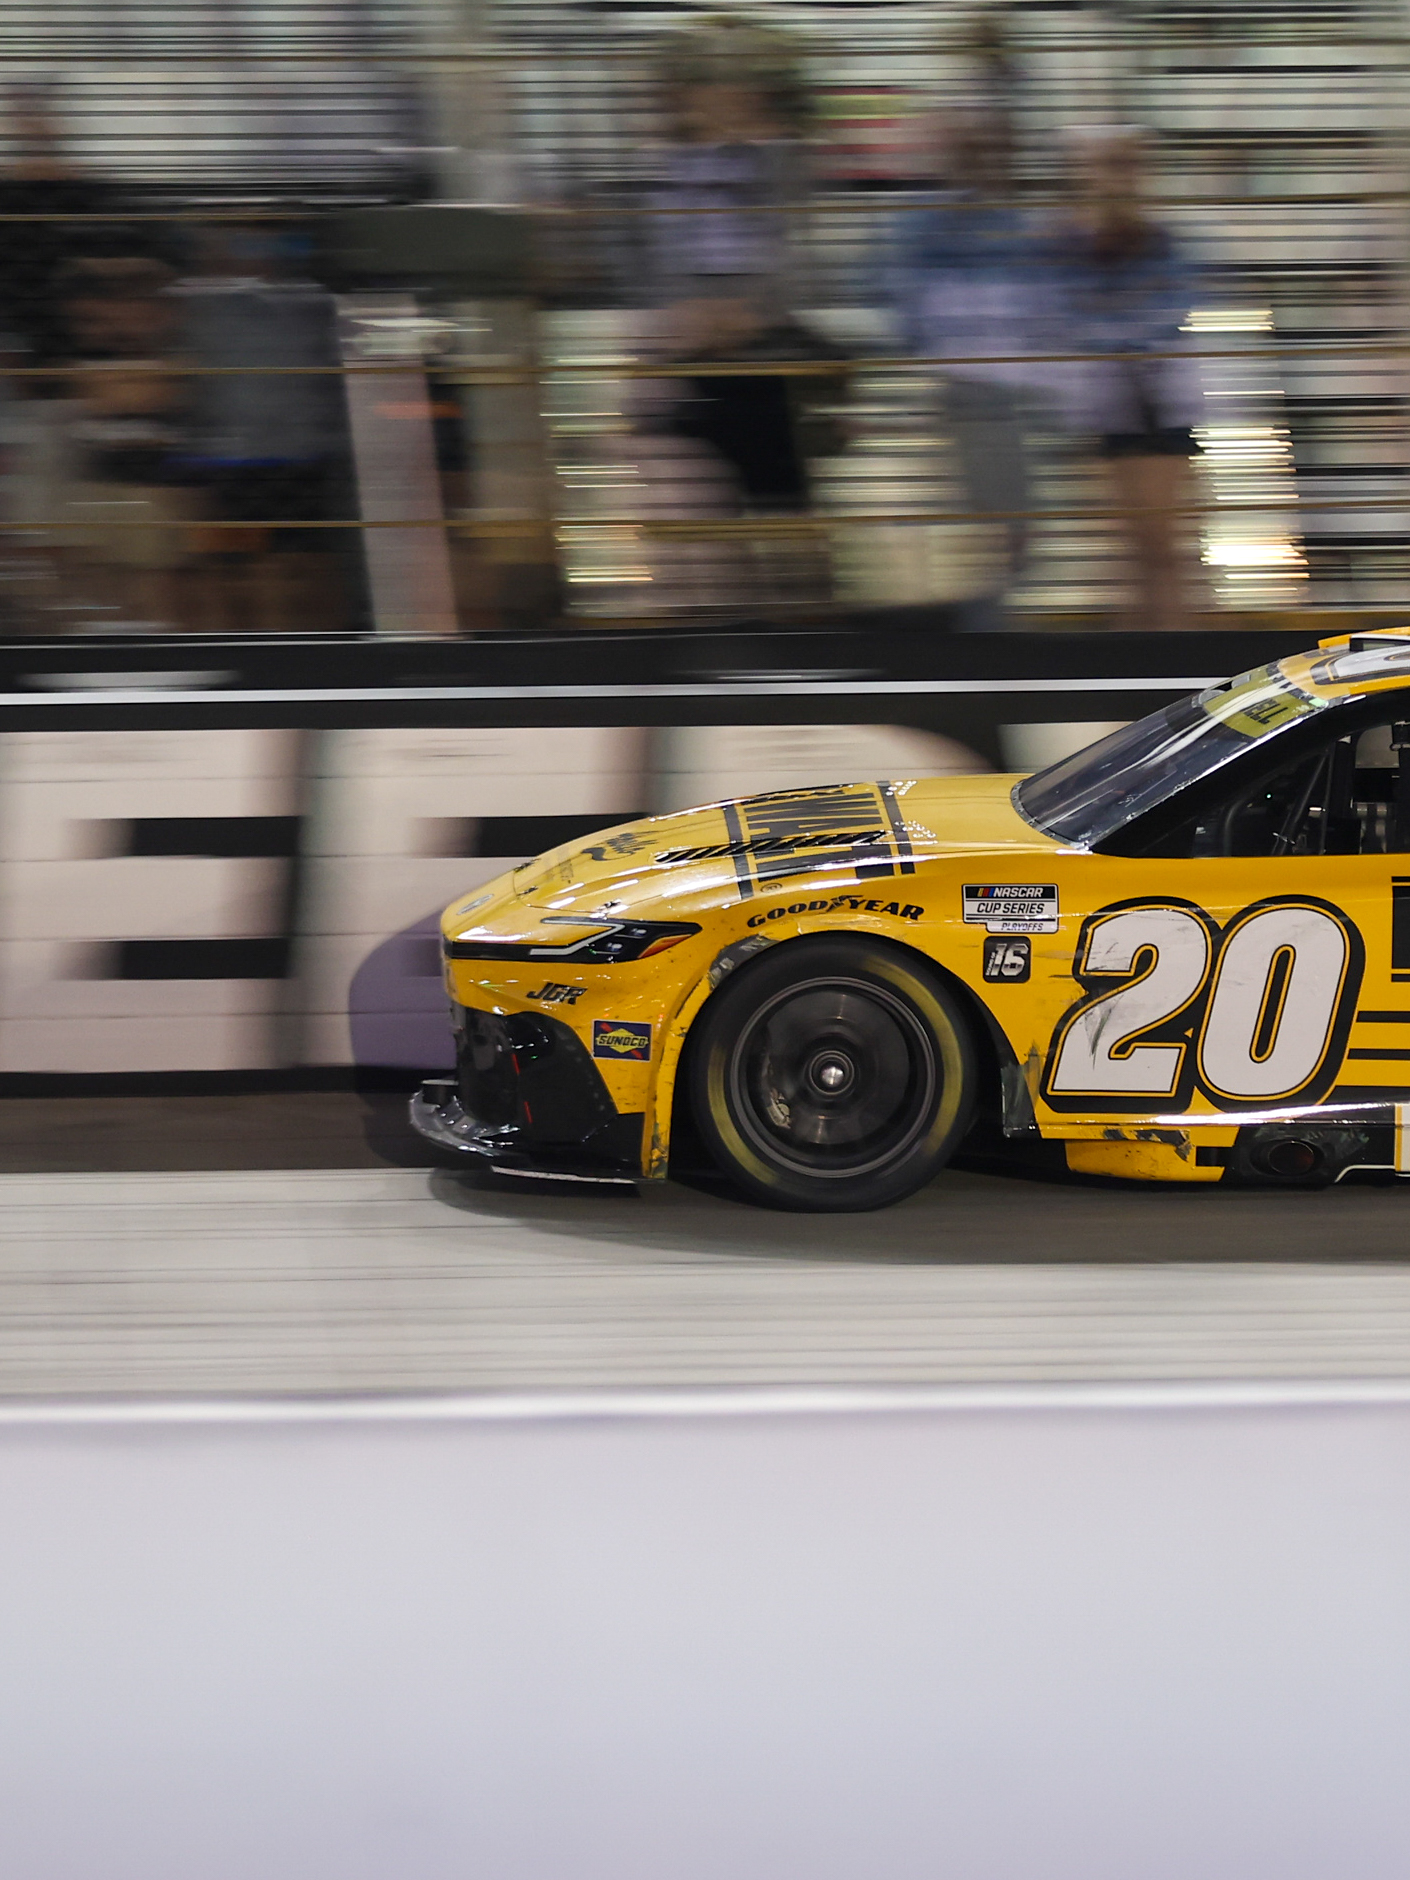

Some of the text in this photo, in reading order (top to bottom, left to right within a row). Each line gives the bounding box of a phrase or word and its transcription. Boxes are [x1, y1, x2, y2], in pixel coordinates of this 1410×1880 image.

[993, 887, 1043, 898] NASCAR
[977, 902, 1045, 914] CUP SERIES
[1001, 922, 1043, 932] PLAYOFFS
[990, 943, 1029, 976] 16
[526, 982, 588, 1006] JGR
[1043, 899, 1358, 1107] 20
[598, 1034, 649, 1048] SUNOCO
